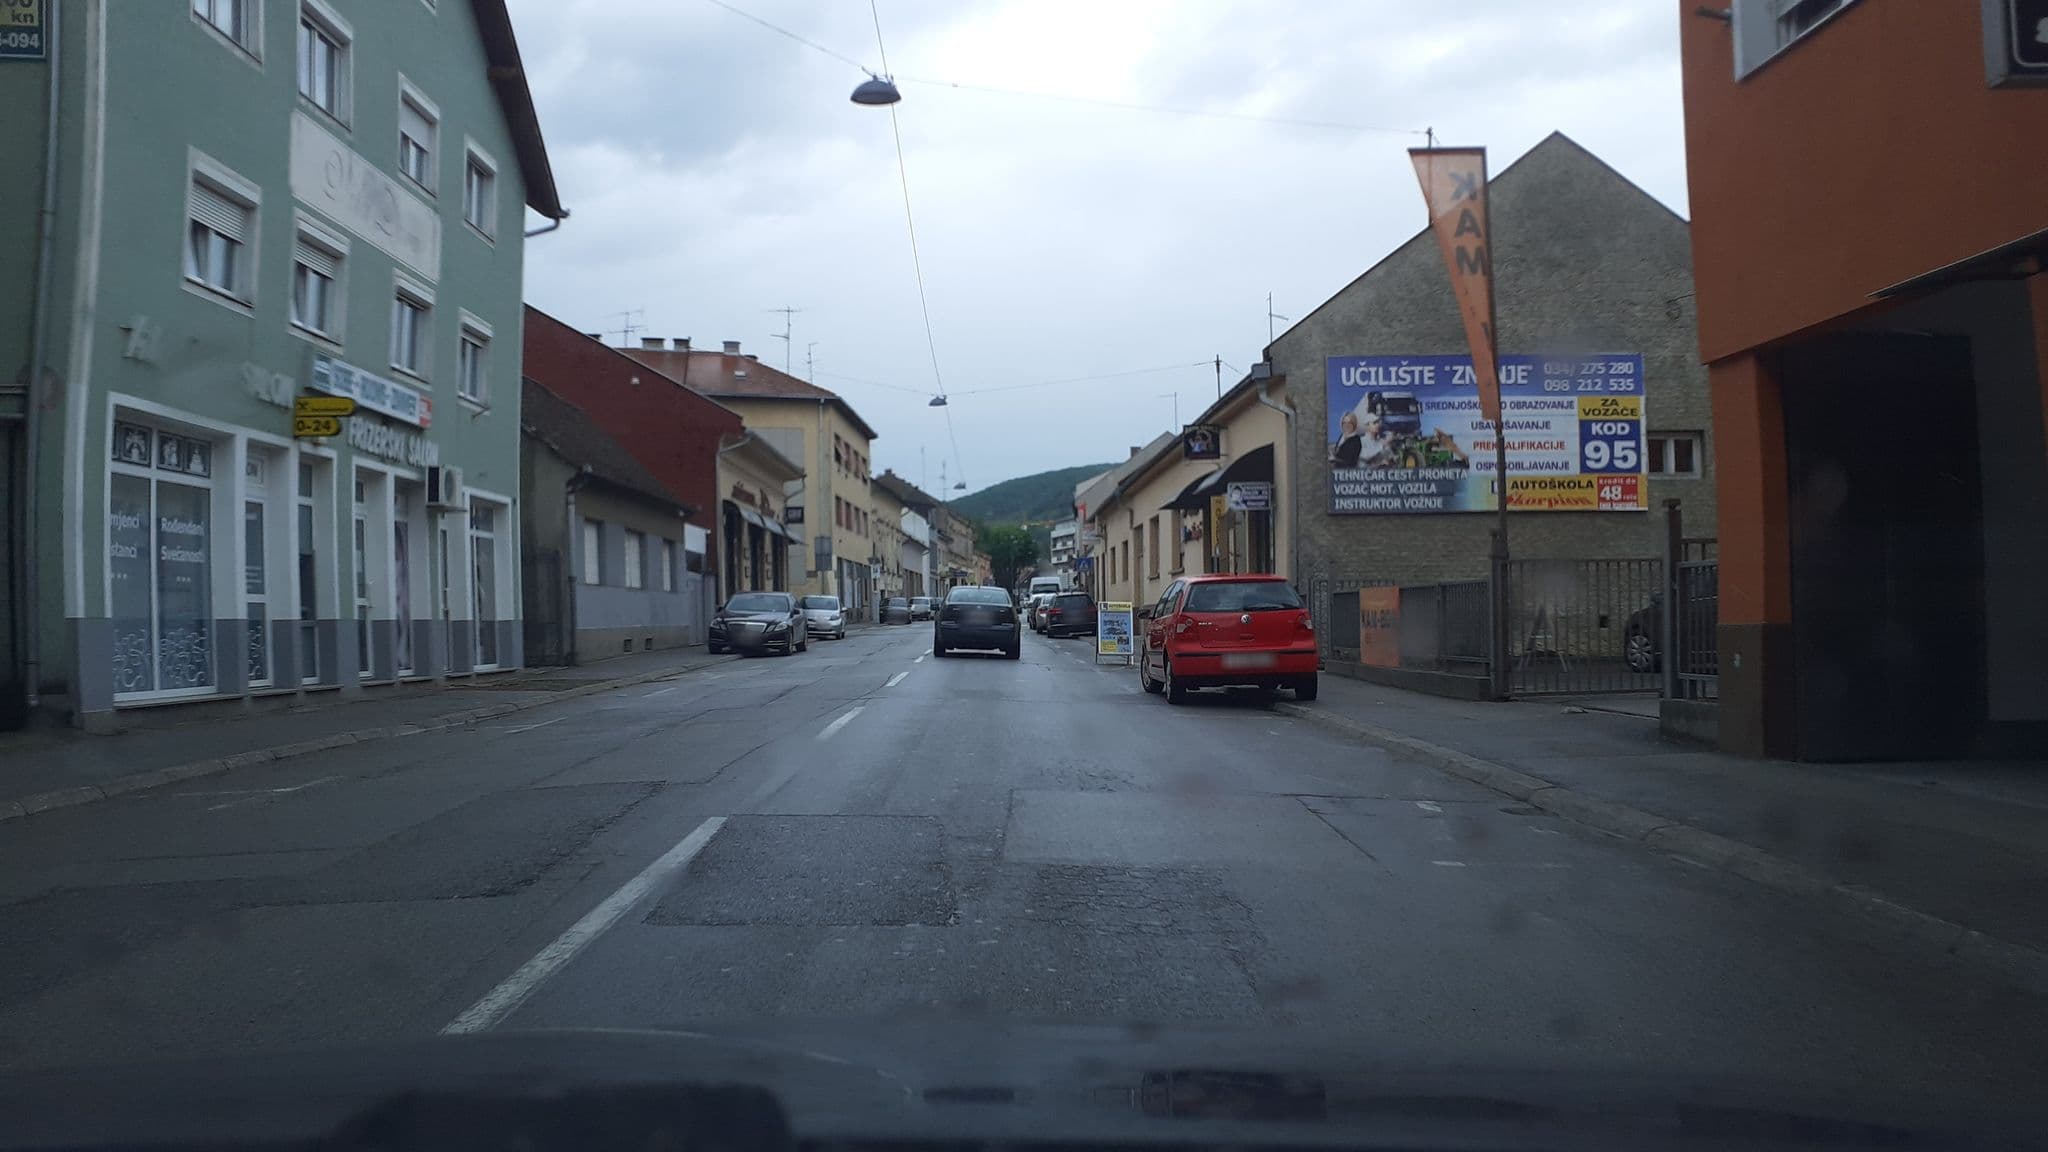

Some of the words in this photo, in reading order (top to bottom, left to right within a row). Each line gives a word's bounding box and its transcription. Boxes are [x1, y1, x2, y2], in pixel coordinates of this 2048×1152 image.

[11, 9, 35, 24] kn
[1341, 360, 1436, 386] UČILIŠTE
[1581, 363, 1605, 374] 275
[1609, 362, 1634, 375] 280
[1544, 379, 1570, 391] 098
[1577, 379, 1602, 391] 212
[1609, 379, 1634, 391] 535
[1509, 401, 1575, 410] OBRAZOVANJE
[1601, 400, 1619, 408] ZA
[1471, 420, 1551, 430] USAVŠAVANJE
[1591, 423, 1630, 435] KOD
[1473, 441, 1565, 450] PREKALIFIKACIJE
[1584, 441, 1637, 470] 95
[1334, 469, 1384, 481] TEHNIČAR
[1419, 469, 1468, 480] PROMETA
[1334, 483, 1366, 495] VOZAČ
[1371, 484, 1395, 494] MOT.
[1400, 484, 1436, 494] VOZILA
[1511, 478, 1594, 489] AUTOŠKOLA
[1601, 486, 1622, 500] 48
[1335, 497, 1401, 509] INSTRUKTOR
[1404, 497, 1443, 508] VOŽNJE
